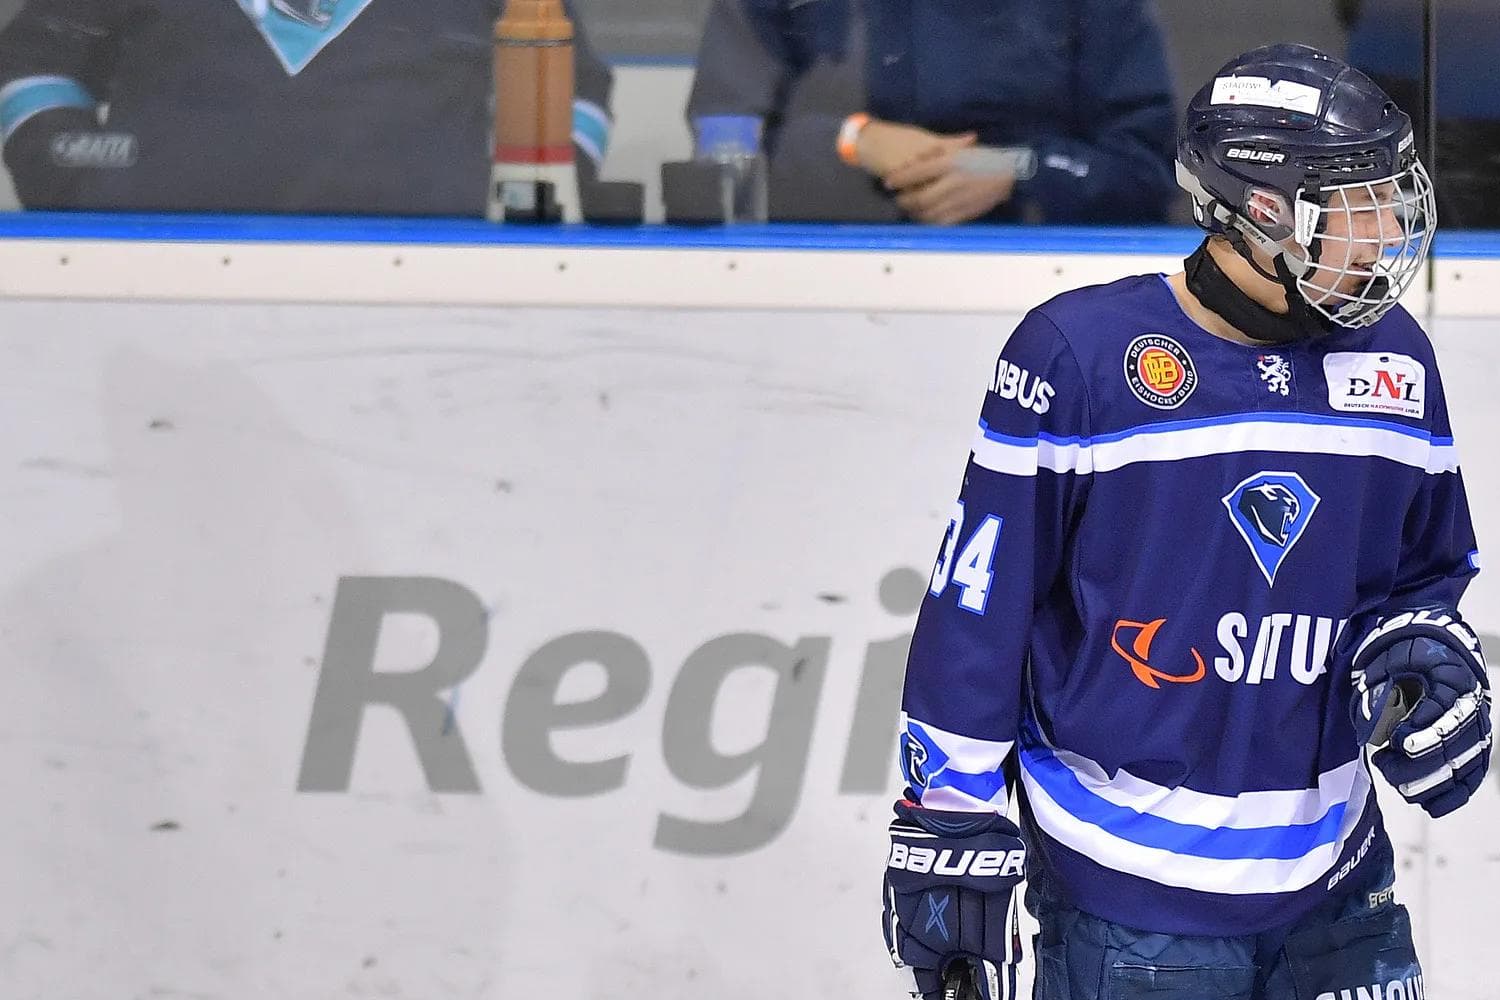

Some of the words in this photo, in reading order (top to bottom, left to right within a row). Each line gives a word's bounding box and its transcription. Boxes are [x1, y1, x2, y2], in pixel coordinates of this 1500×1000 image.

[1226, 148, 1285, 162] BAUER
[1346, 370, 1420, 402] DNL
[889, 843, 1025, 877] BAUER
[1327, 825, 1376, 891] BAUER
